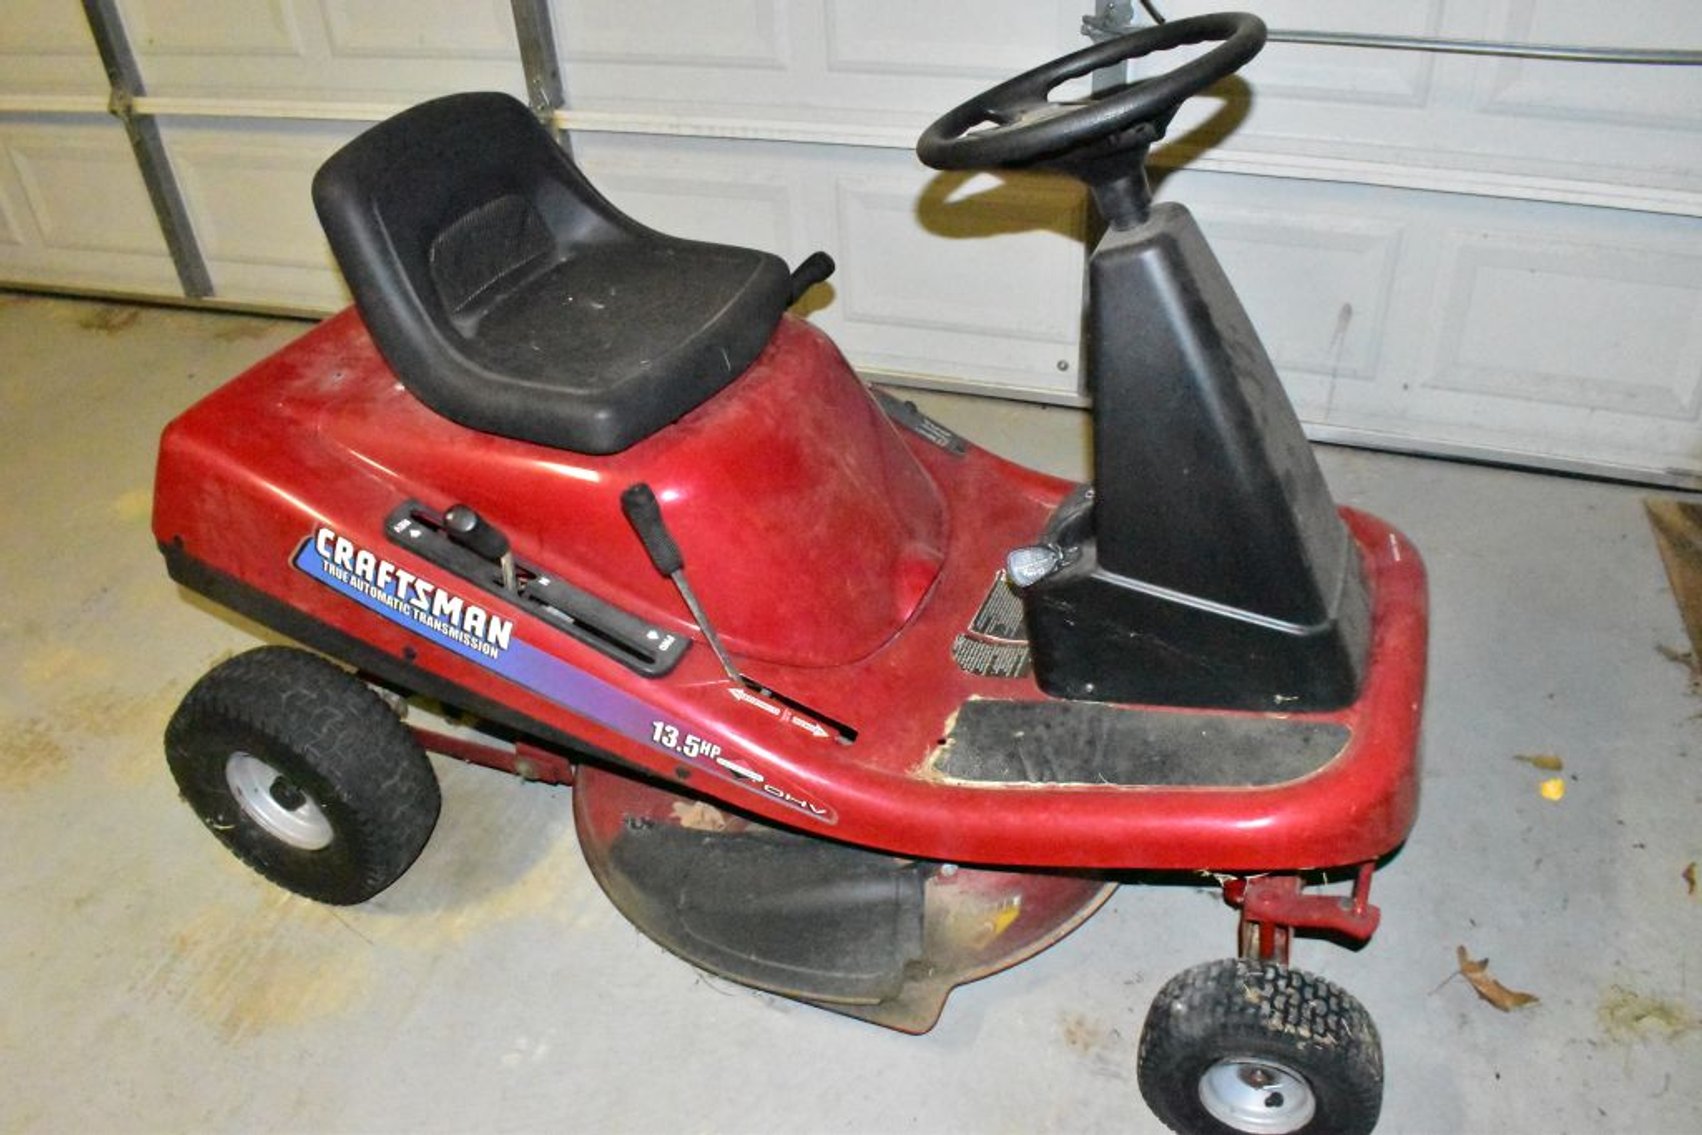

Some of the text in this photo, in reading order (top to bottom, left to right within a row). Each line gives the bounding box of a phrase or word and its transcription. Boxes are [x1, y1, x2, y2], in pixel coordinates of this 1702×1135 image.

[313, 528, 513, 649] CRAFTSMAN
[323, 560, 499, 659] TRUE AUTOMATIC TRANSMISSION
